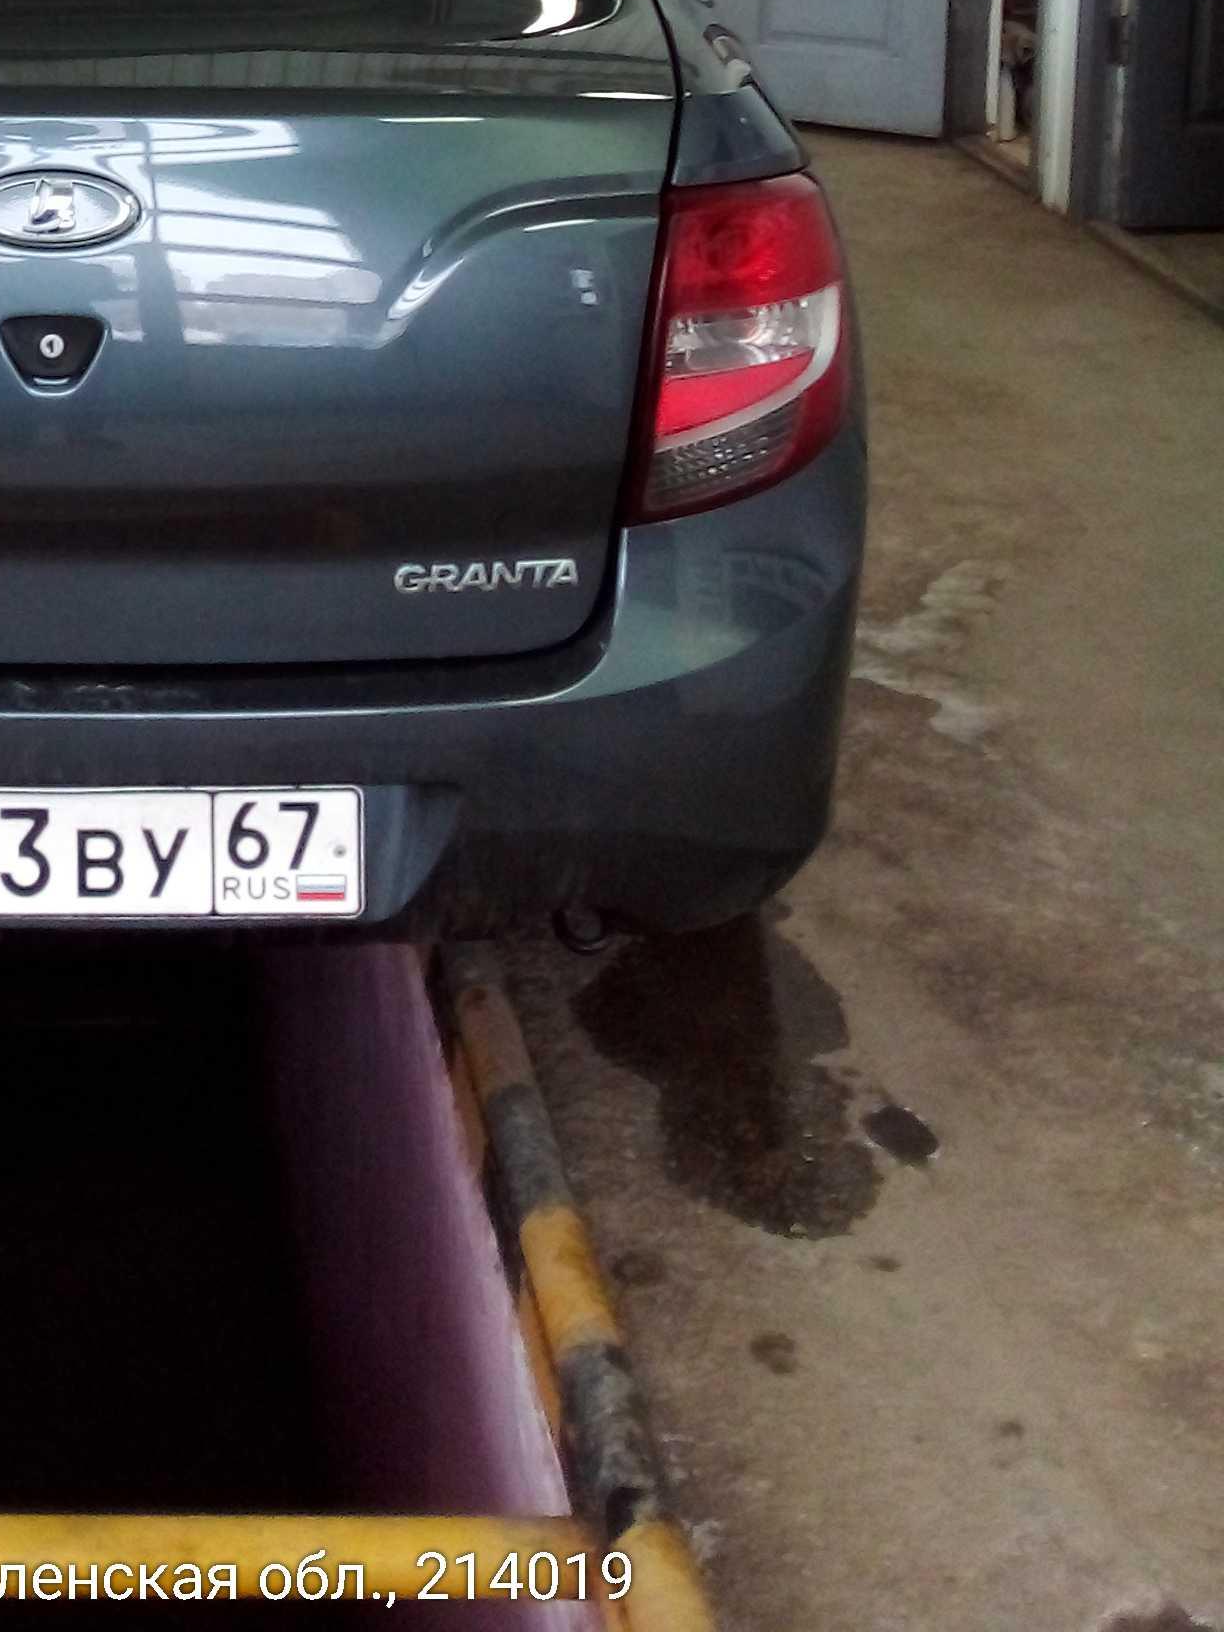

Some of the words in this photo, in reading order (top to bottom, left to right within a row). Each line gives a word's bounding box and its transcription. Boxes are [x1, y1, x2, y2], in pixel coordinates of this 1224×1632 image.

[393, 558, 578, 594] GRANTA
[226, 801, 321, 871] 67
[222, 875, 291, 901] RUS
